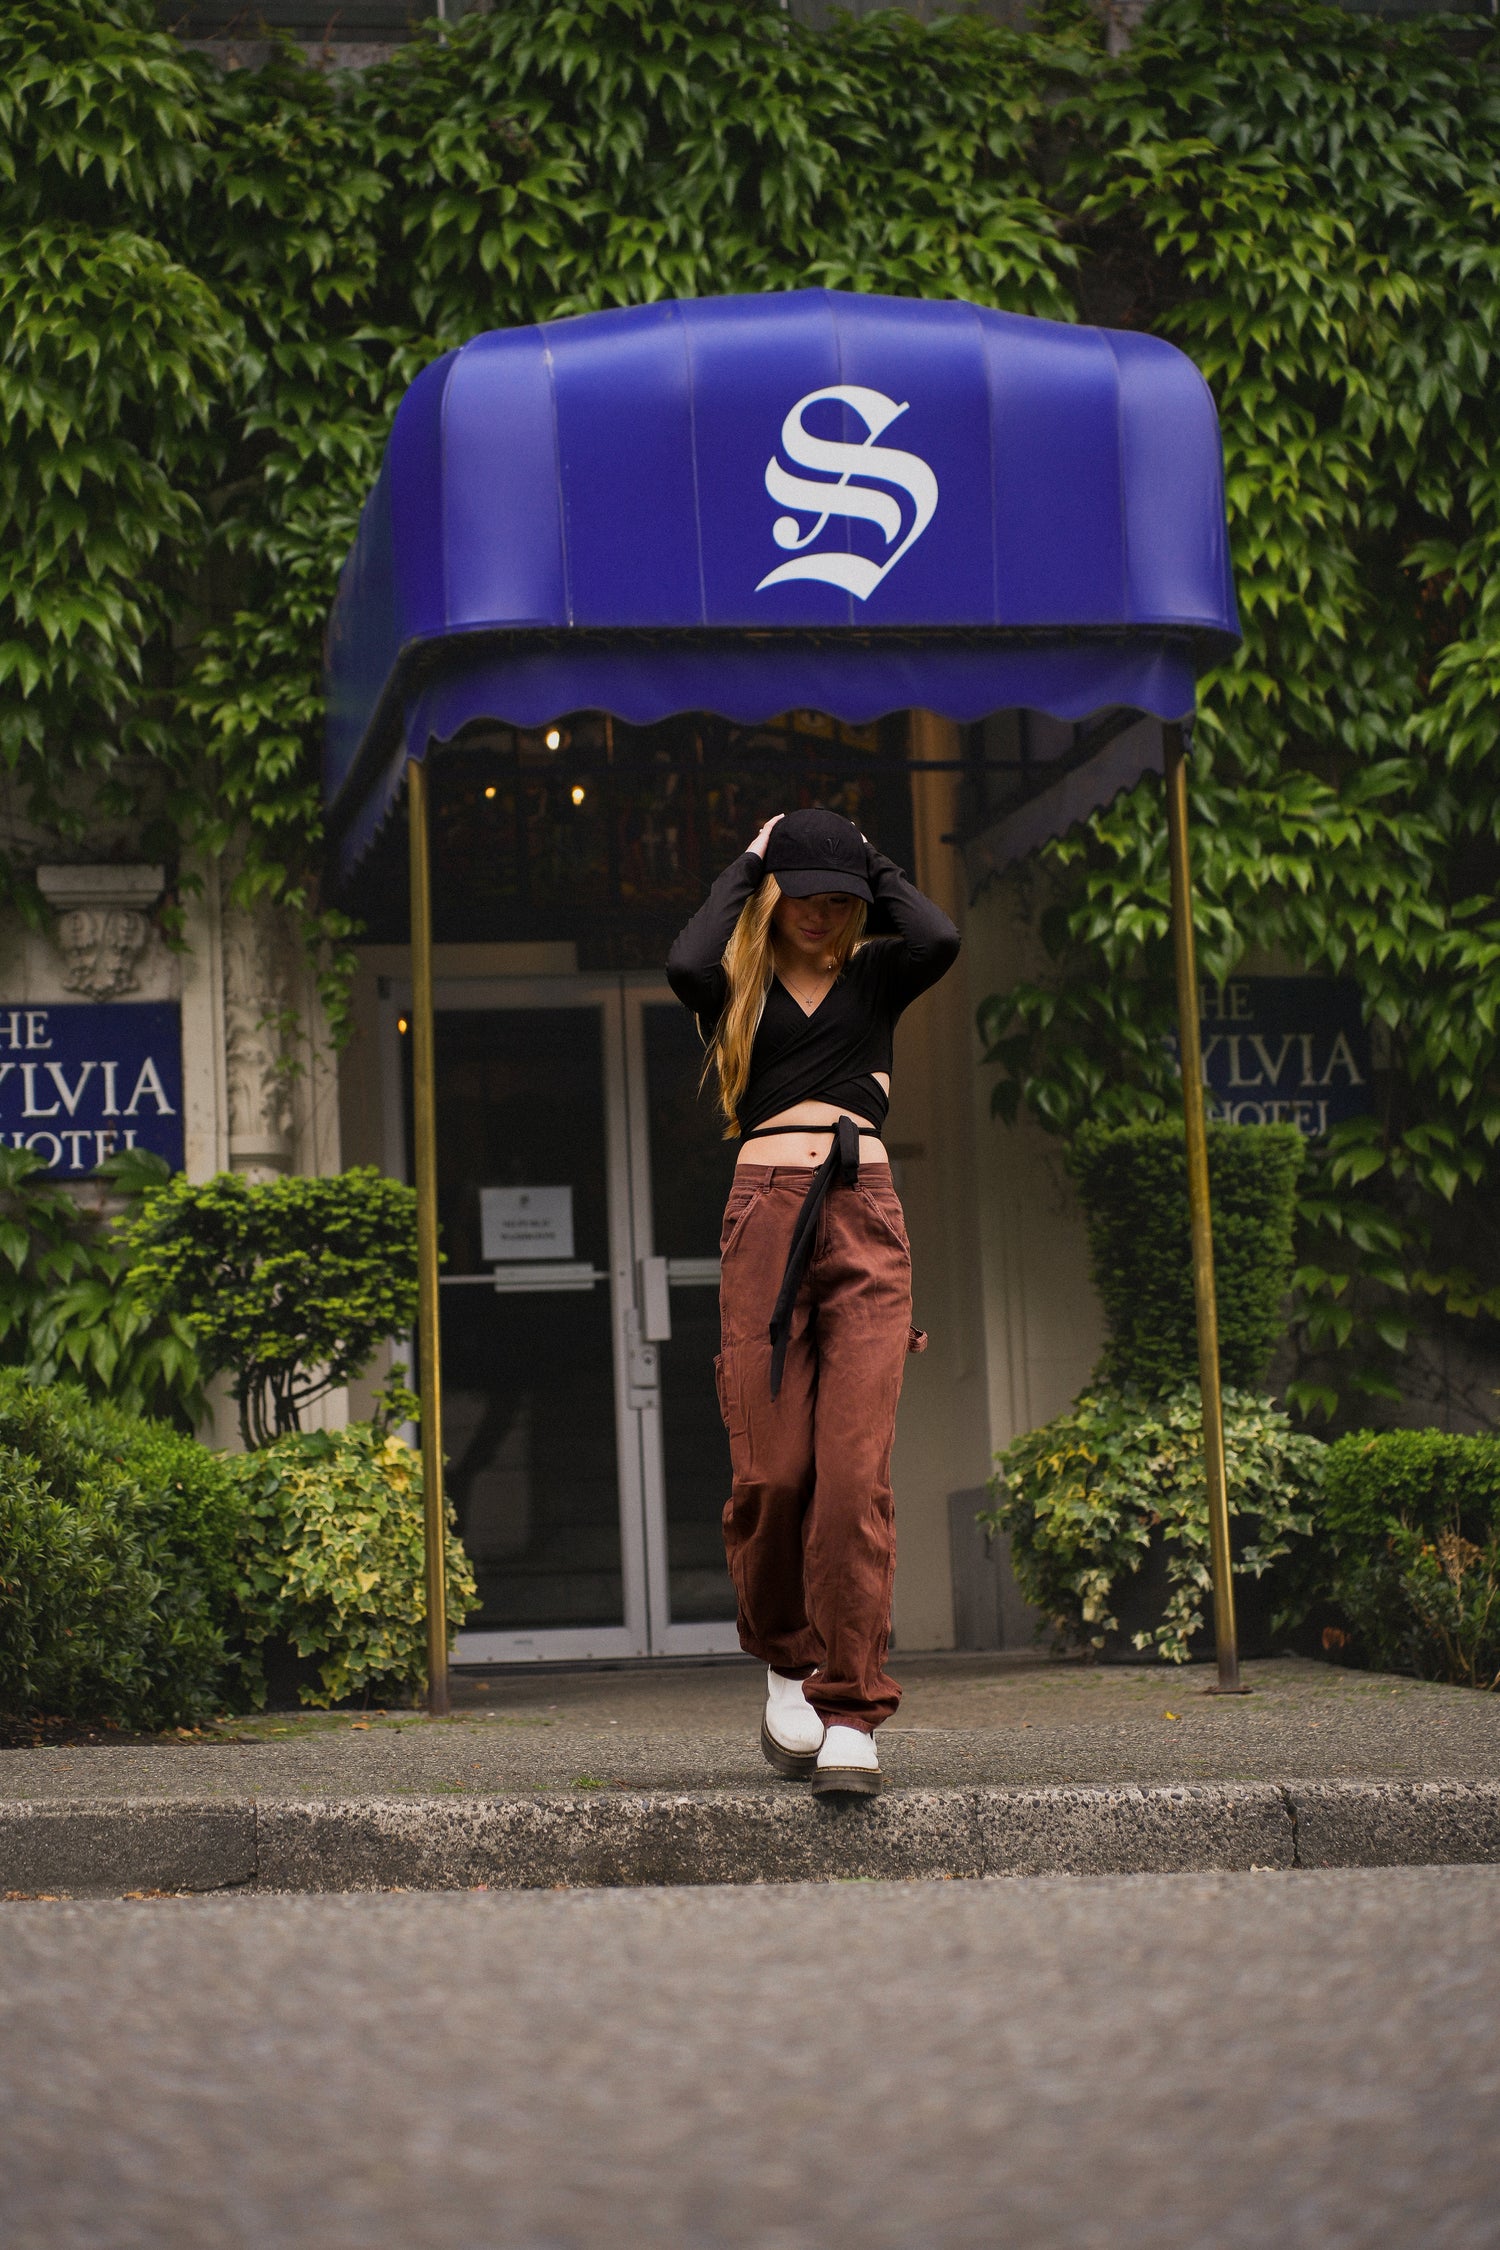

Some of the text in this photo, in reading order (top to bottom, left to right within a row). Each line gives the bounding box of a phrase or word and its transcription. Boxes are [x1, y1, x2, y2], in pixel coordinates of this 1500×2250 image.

[754, 384, 939, 602] S
[1200, 983, 1254, 1021] HE
[0, 1011, 53, 1049] HE
[1161, 1030, 1366, 1087] YLVIA
